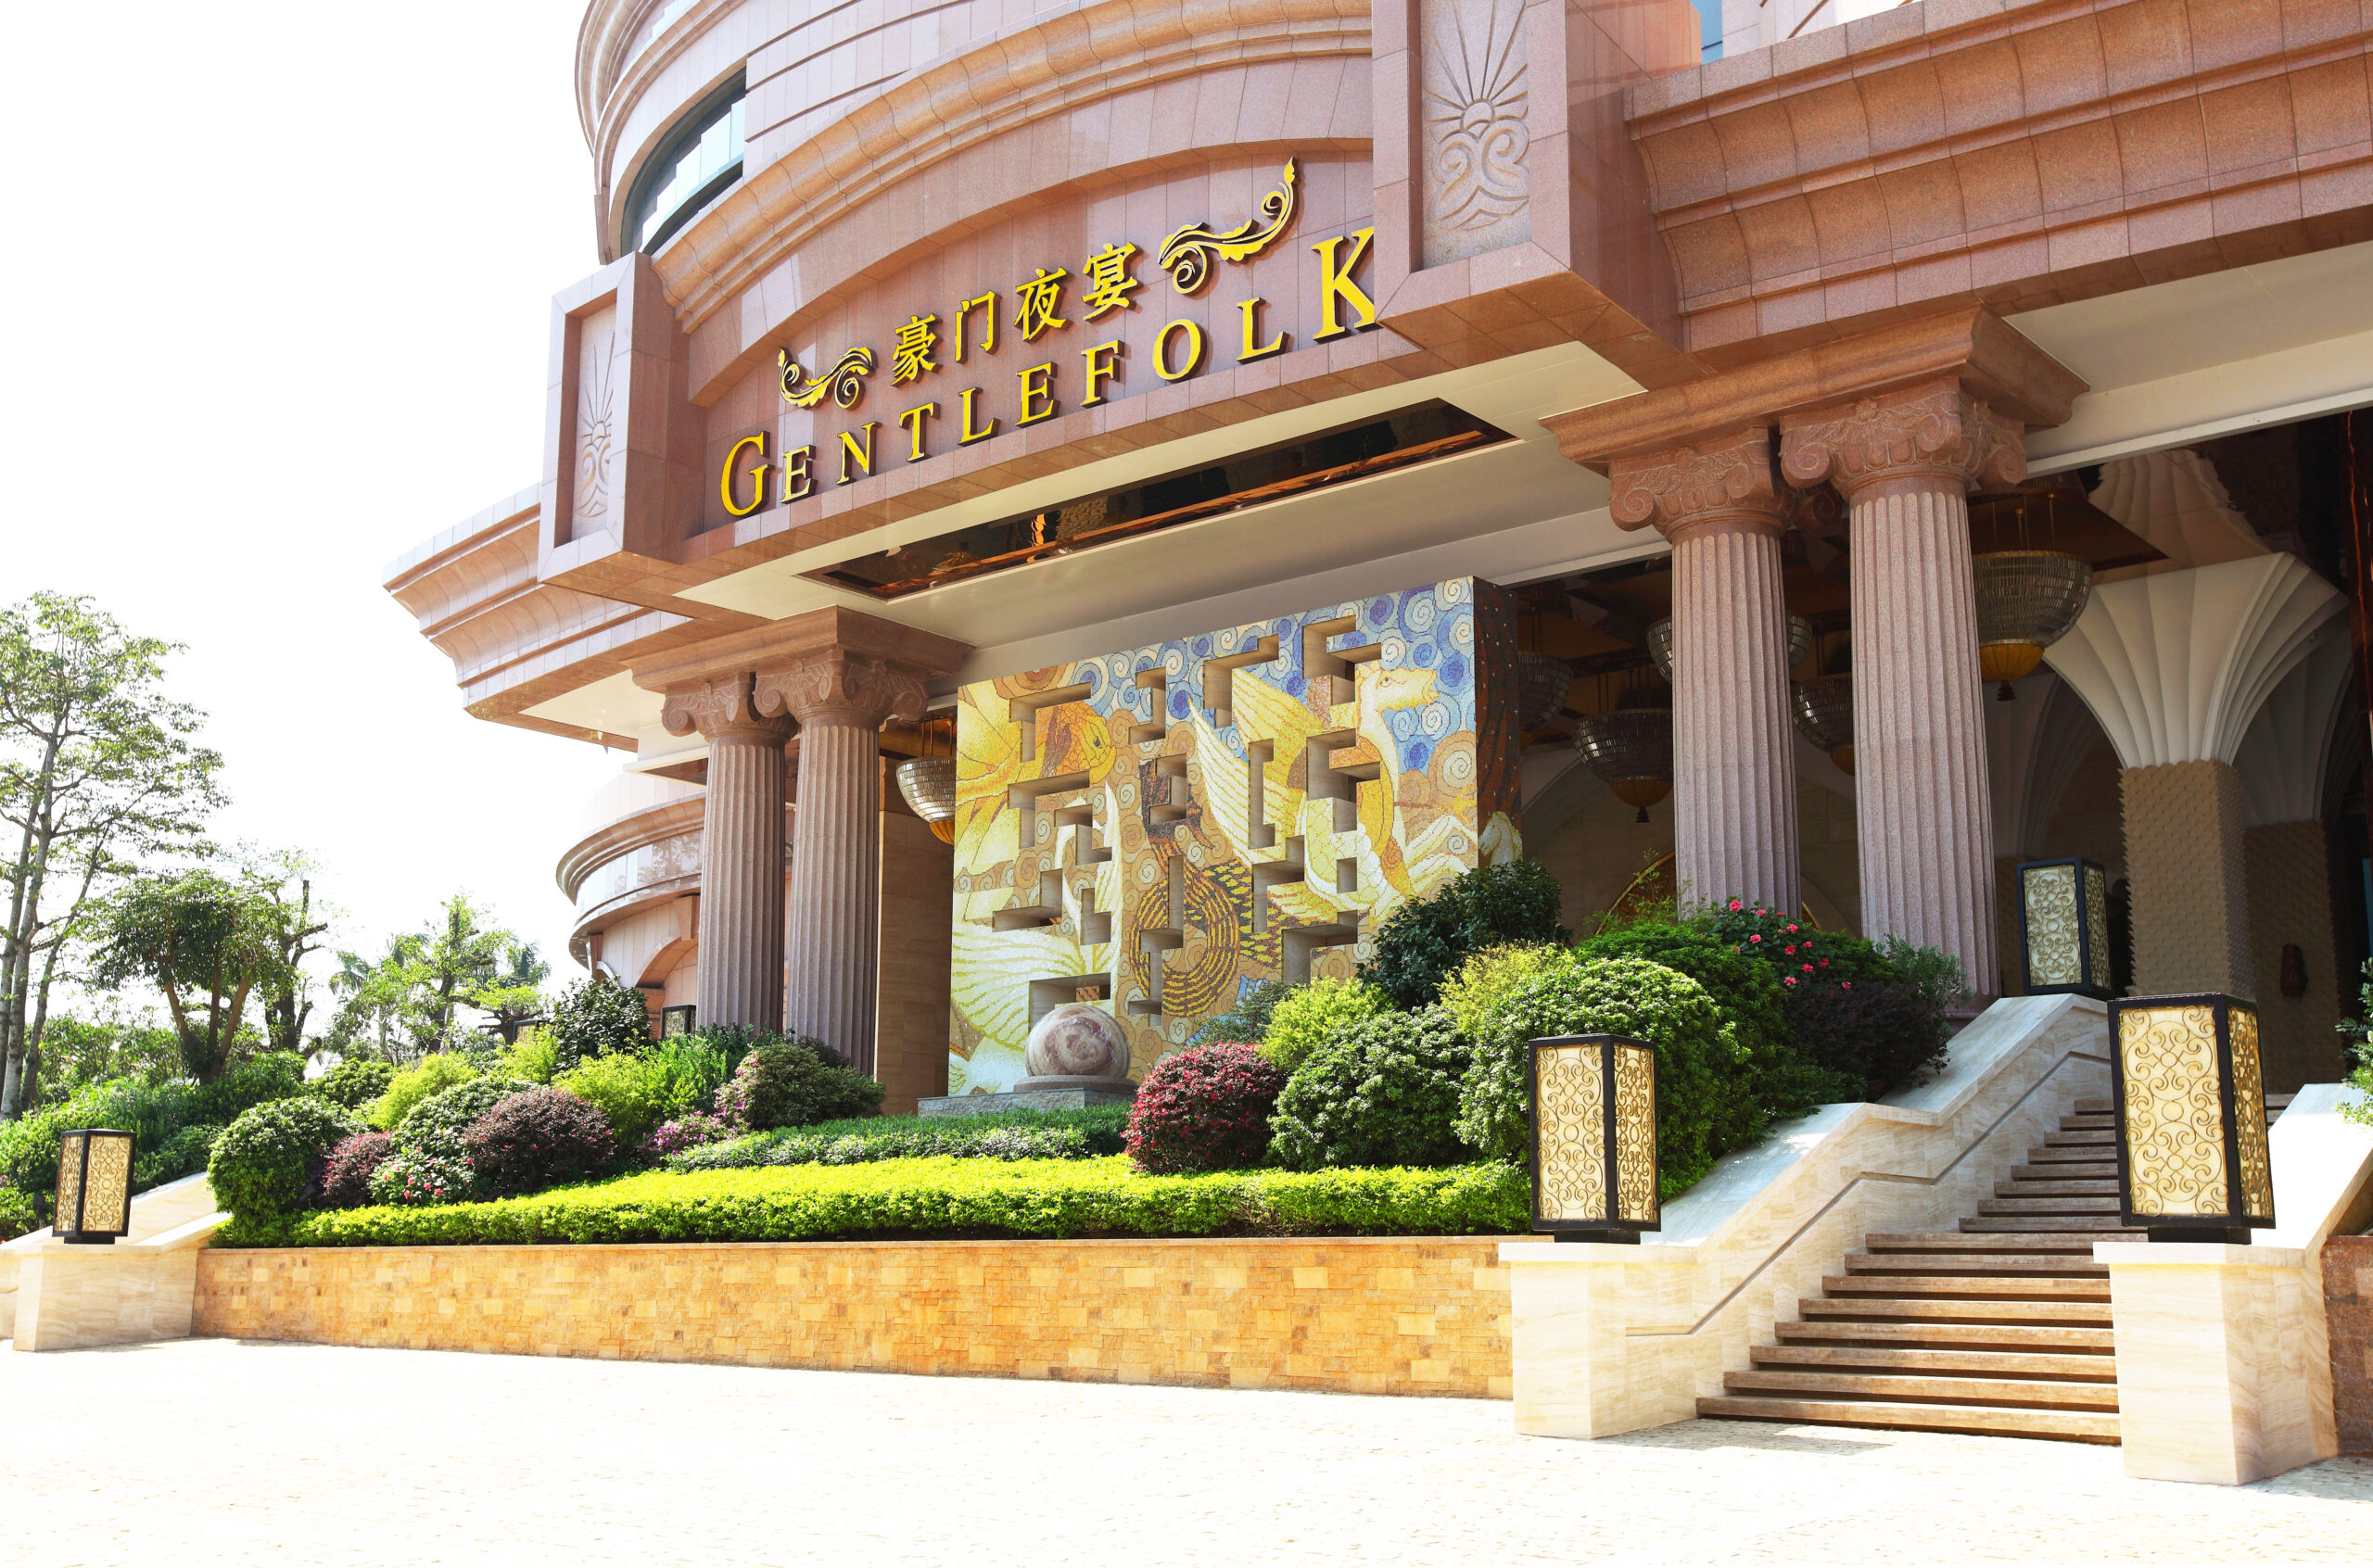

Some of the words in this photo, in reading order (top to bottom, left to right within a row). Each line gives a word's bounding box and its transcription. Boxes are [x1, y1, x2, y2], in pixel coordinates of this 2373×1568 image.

[720, 226, 1375, 516] GENTLEFOLK
[891, 242, 1138, 387] 豪门夜宴
